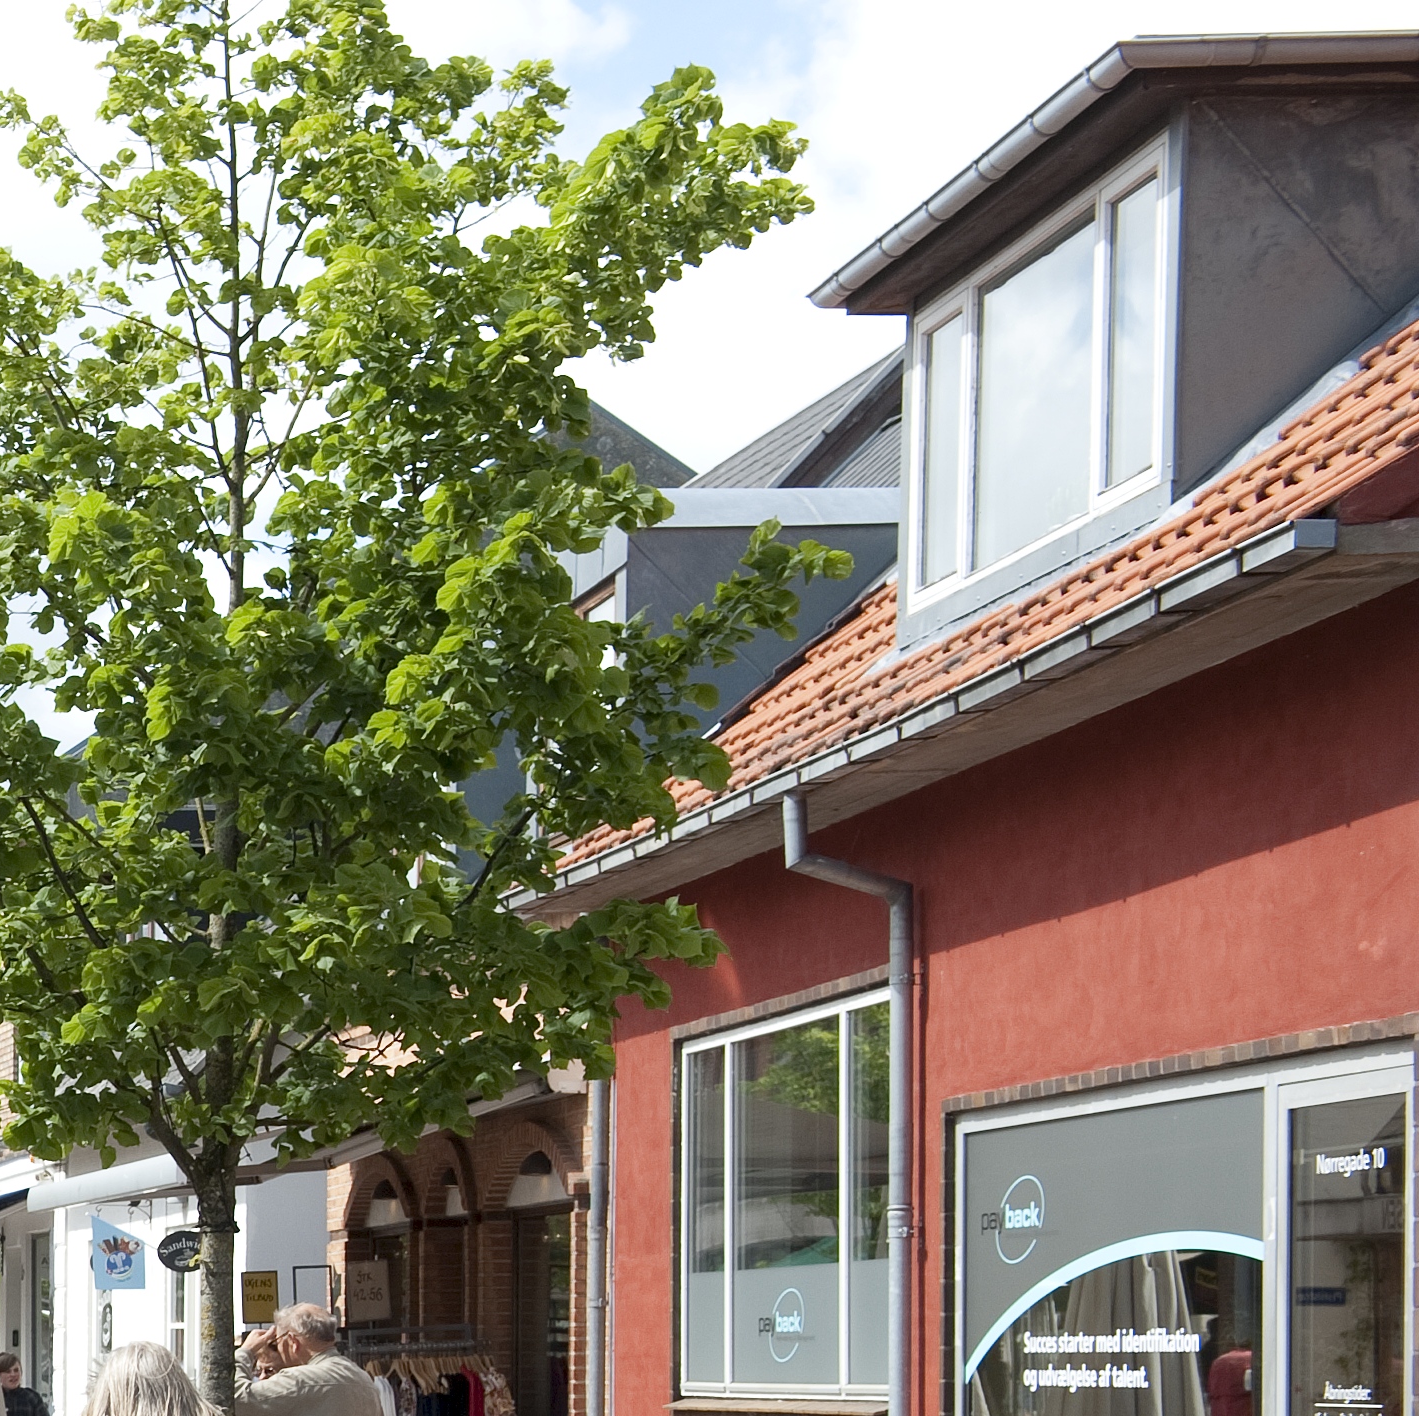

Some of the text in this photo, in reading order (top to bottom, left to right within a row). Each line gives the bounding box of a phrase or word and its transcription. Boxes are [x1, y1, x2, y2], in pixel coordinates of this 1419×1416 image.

[1316, 1147, 1386, 1177] Nørregade 10
[981, 1200, 1040, 1236] payback
[758, 1310, 802, 1337] payback
[1023, 1327, 1201, 1354] Succes starter med identifikation
[1023, 1369, 1039, 1393] og
[1039, 1363, 1098, 1394] udvælgelse
[1098, 1363, 1111, 1388] af
